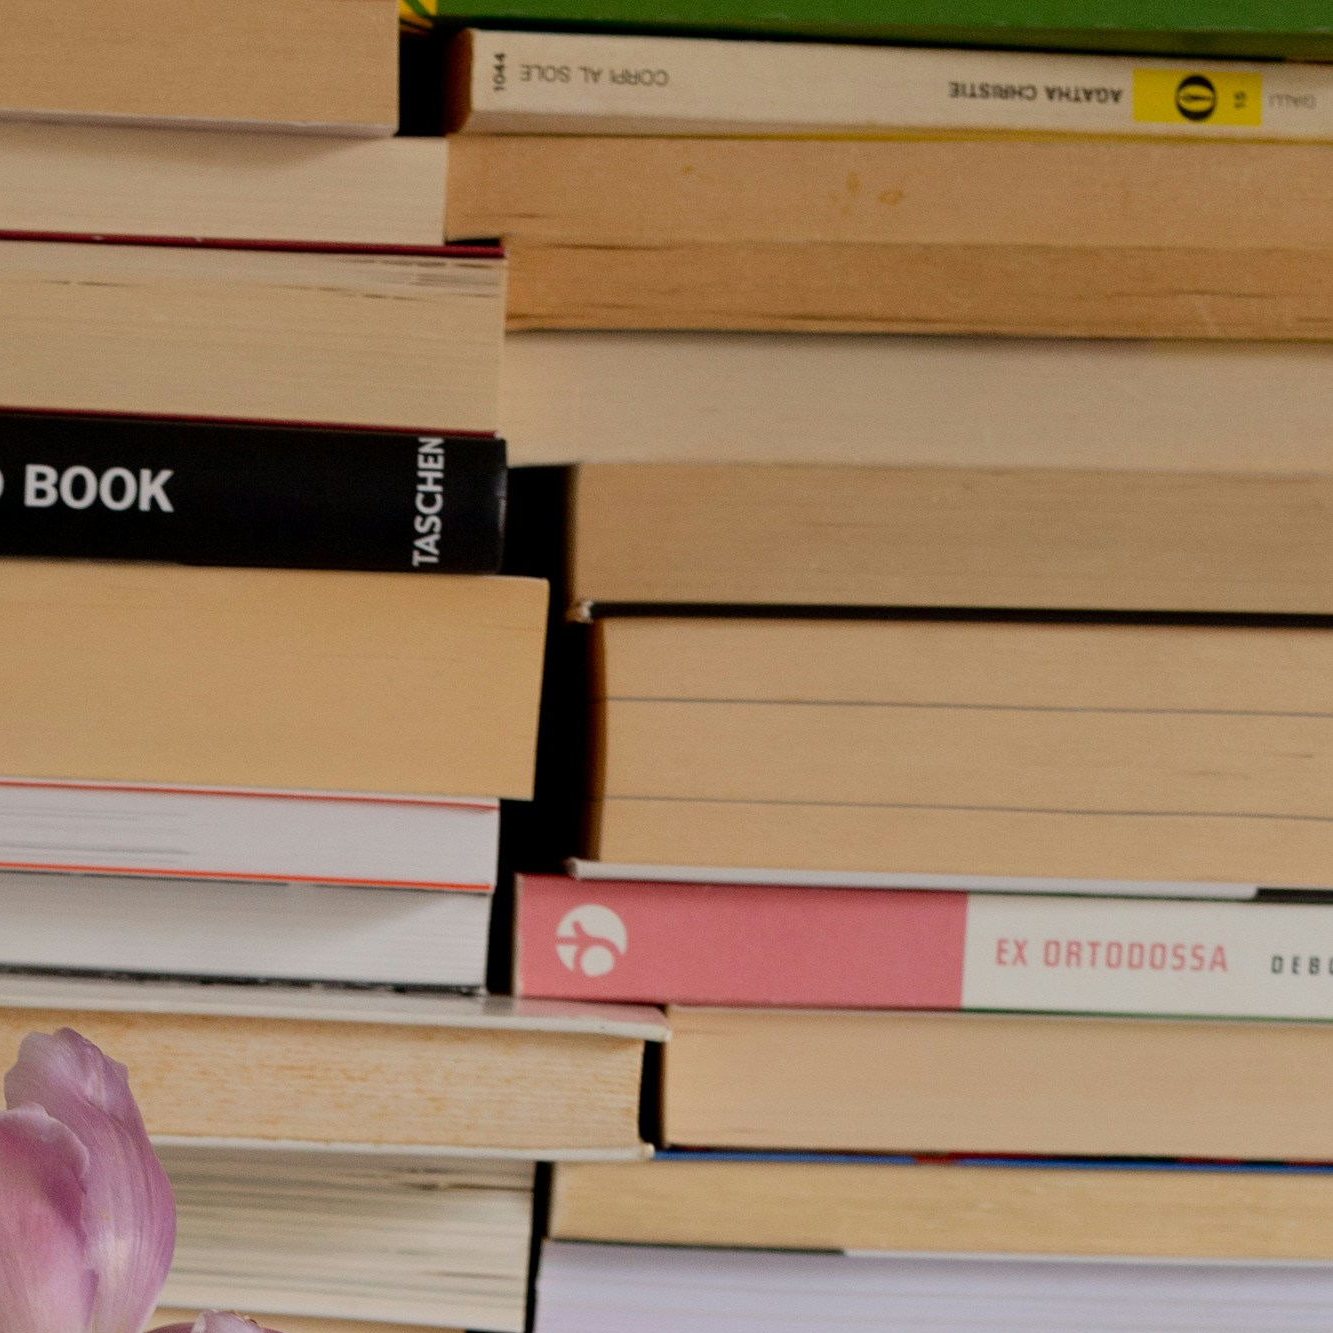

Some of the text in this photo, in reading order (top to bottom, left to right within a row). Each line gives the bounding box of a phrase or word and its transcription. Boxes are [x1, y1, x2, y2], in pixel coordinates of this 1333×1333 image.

[492, 51, 507, 92] 1044
[519, 62, 671, 89] CORPI AL SOLE
[948, 80, 1124, 106] AGATHA CHRISTIE
[23, 462, 175, 515] BOOK
[411, 436, 446, 568] TASCHEN
[994, 937, 1230, 974] EX ORTODOSSA
